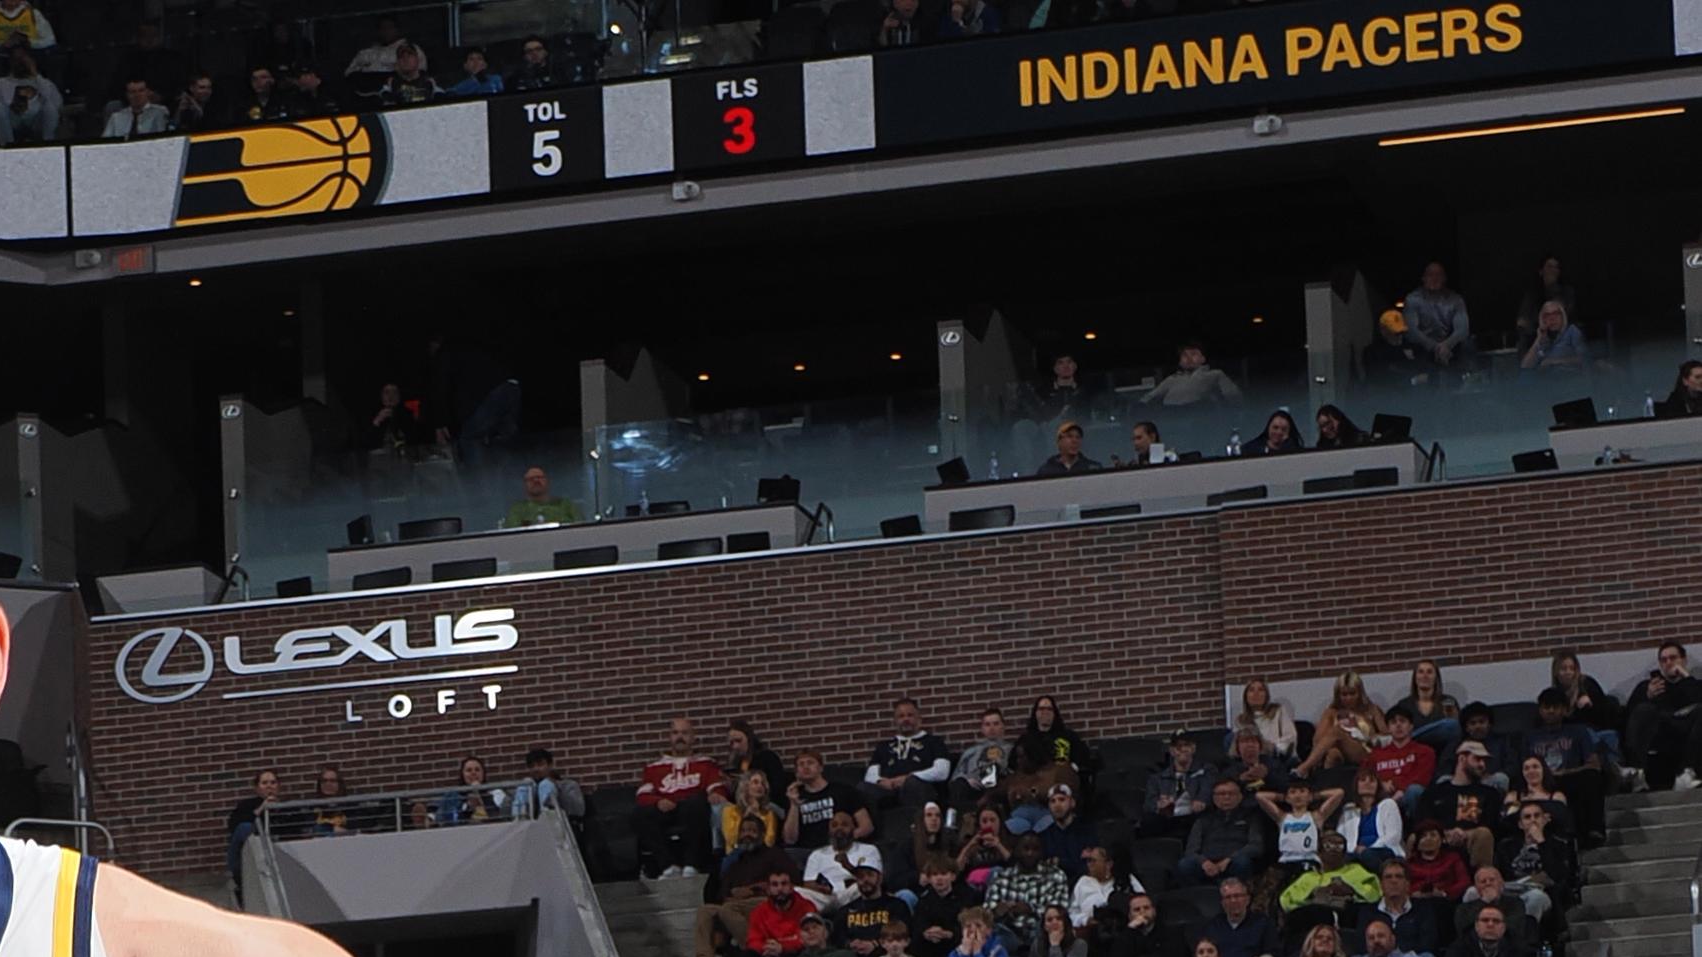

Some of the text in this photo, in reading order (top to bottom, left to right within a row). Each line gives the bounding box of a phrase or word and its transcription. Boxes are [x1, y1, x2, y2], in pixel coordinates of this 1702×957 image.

[1018, 3, 1523, 107] INDIANA PACERS
[716, 78, 758, 100] FLS
[523, 101, 566, 123] TOL
[722, 106, 756, 155] 3
[531, 129, 563, 177] 5
[223, 608, 519, 676] LEXUS
[346, 684, 503, 723] LOFT
[847, 909, 890, 929] PACERS
